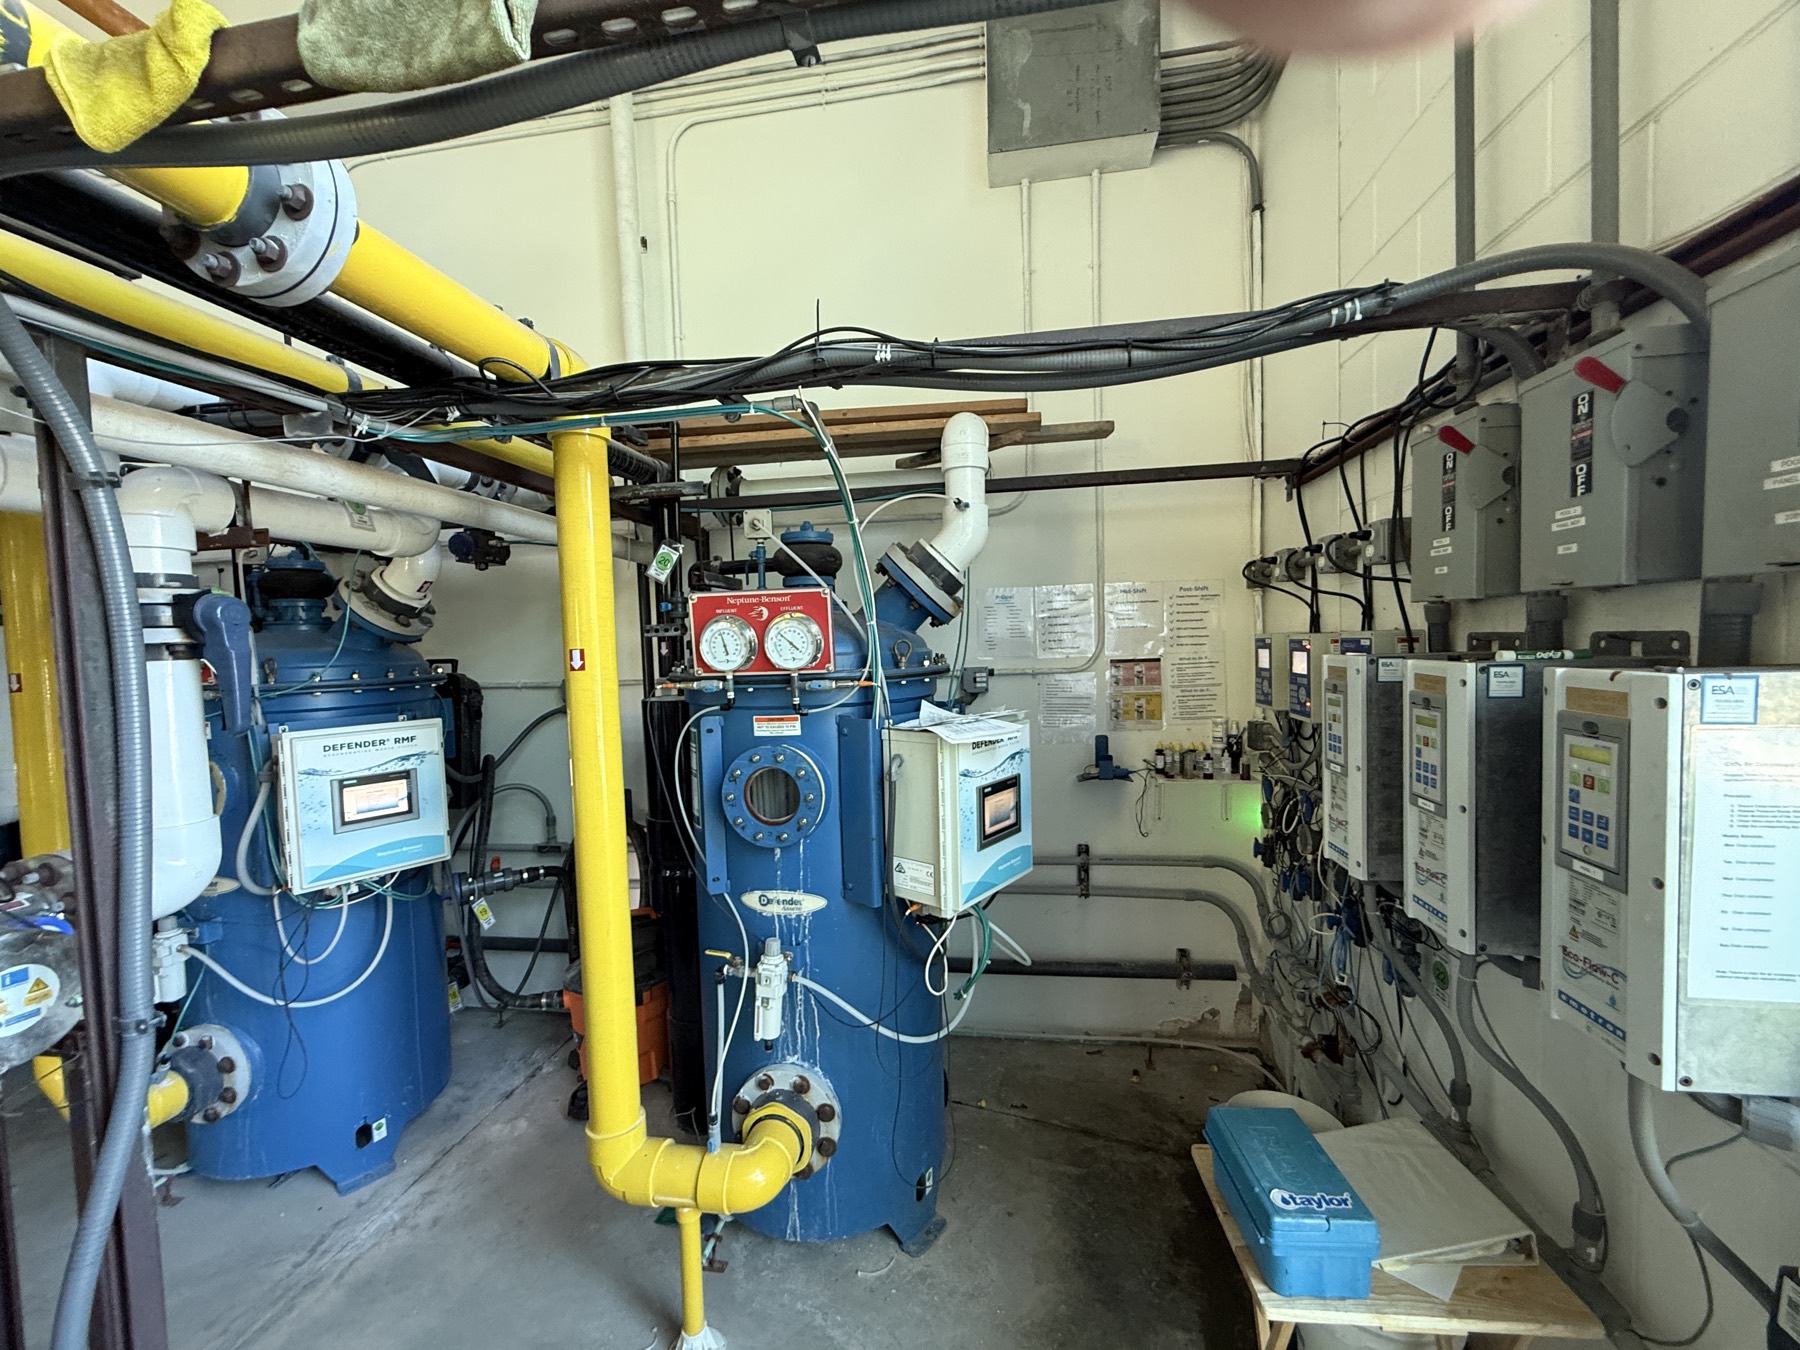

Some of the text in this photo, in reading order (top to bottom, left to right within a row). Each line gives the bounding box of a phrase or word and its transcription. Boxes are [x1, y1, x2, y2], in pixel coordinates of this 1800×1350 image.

[1577, 393, 1589, 415] ON
[1446, 453, 1454, 468] ON
[1575, 463, 1587, 497] OFF
[1444, 506, 1453, 532] OFF
[658, 556, 670, 566] 20
[726, 595, 792, 606] Neptune-Benson
[1712, 686, 1735, 695] ESA
[394, 735, 417, 745] RMF
[478, 907, 488, 917] 19
[1561, 945, 1619, 985] Eco-Flow-C
[1560, 994, 1623, 1038] emotron
[1289, 1194, 1350, 1209] taylor
